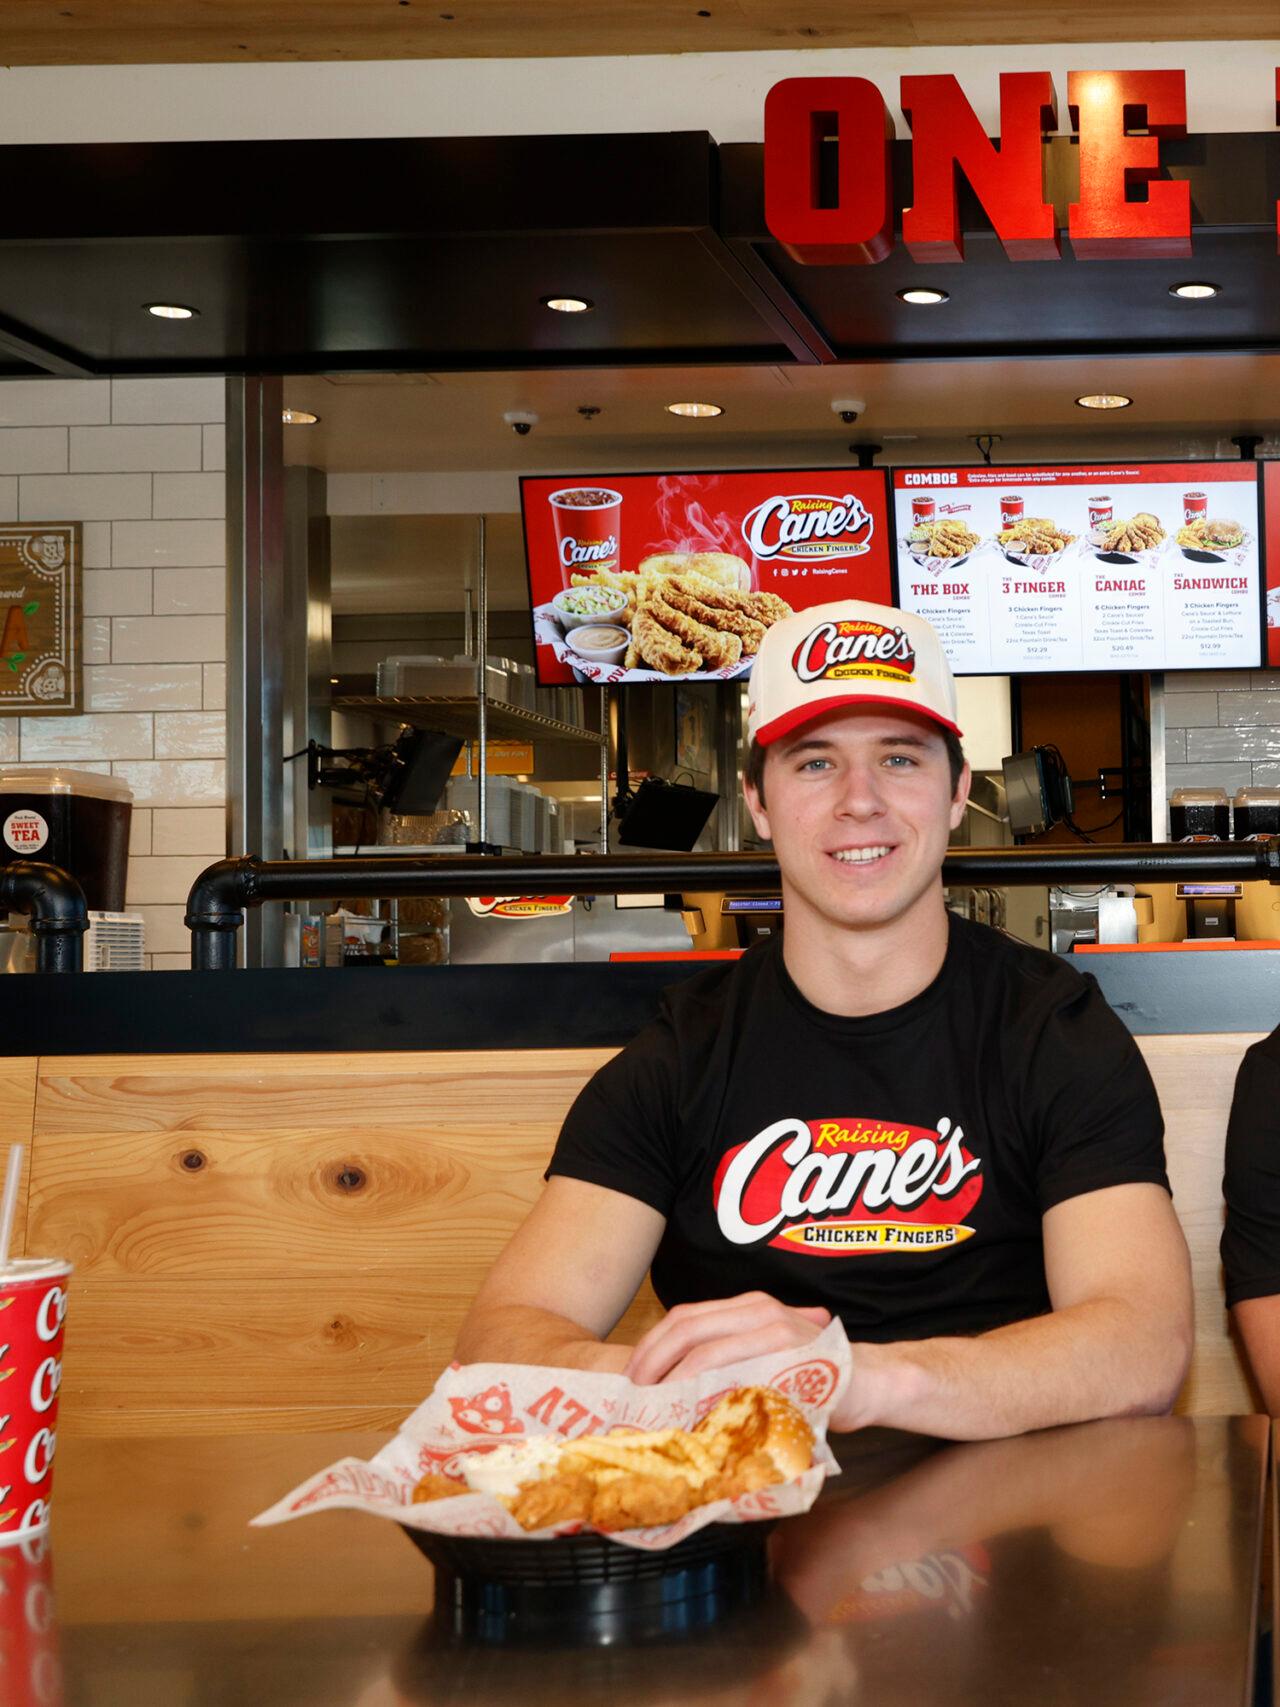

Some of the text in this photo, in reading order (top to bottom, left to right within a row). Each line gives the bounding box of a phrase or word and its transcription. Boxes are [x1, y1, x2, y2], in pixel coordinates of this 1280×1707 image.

[764, 70, 1192, 252] ONE
[904, 472, 958, 486] COMBOS
[791, 499, 834, 513] Raising
[751, 495, 871, 556] Cane's
[560, 535, 618, 567] Cane's
[911, 583, 970, 596] THE BOX
[1002, 581, 1066, 594] 3 FINGER
[1095, 579, 1146, 592] CANIAC
[1174, 577, 1248, 590] SANDWICH
[840, 622, 884, 636] Raising
[797, 622, 915, 683] Cane's
[11, 829, 41, 842] TEA
[815, 1123, 910, 1151] Raising
[717, 1117, 982, 1245] Cane's
[803, 1226, 954, 1244] CHICKEN FINGERS
